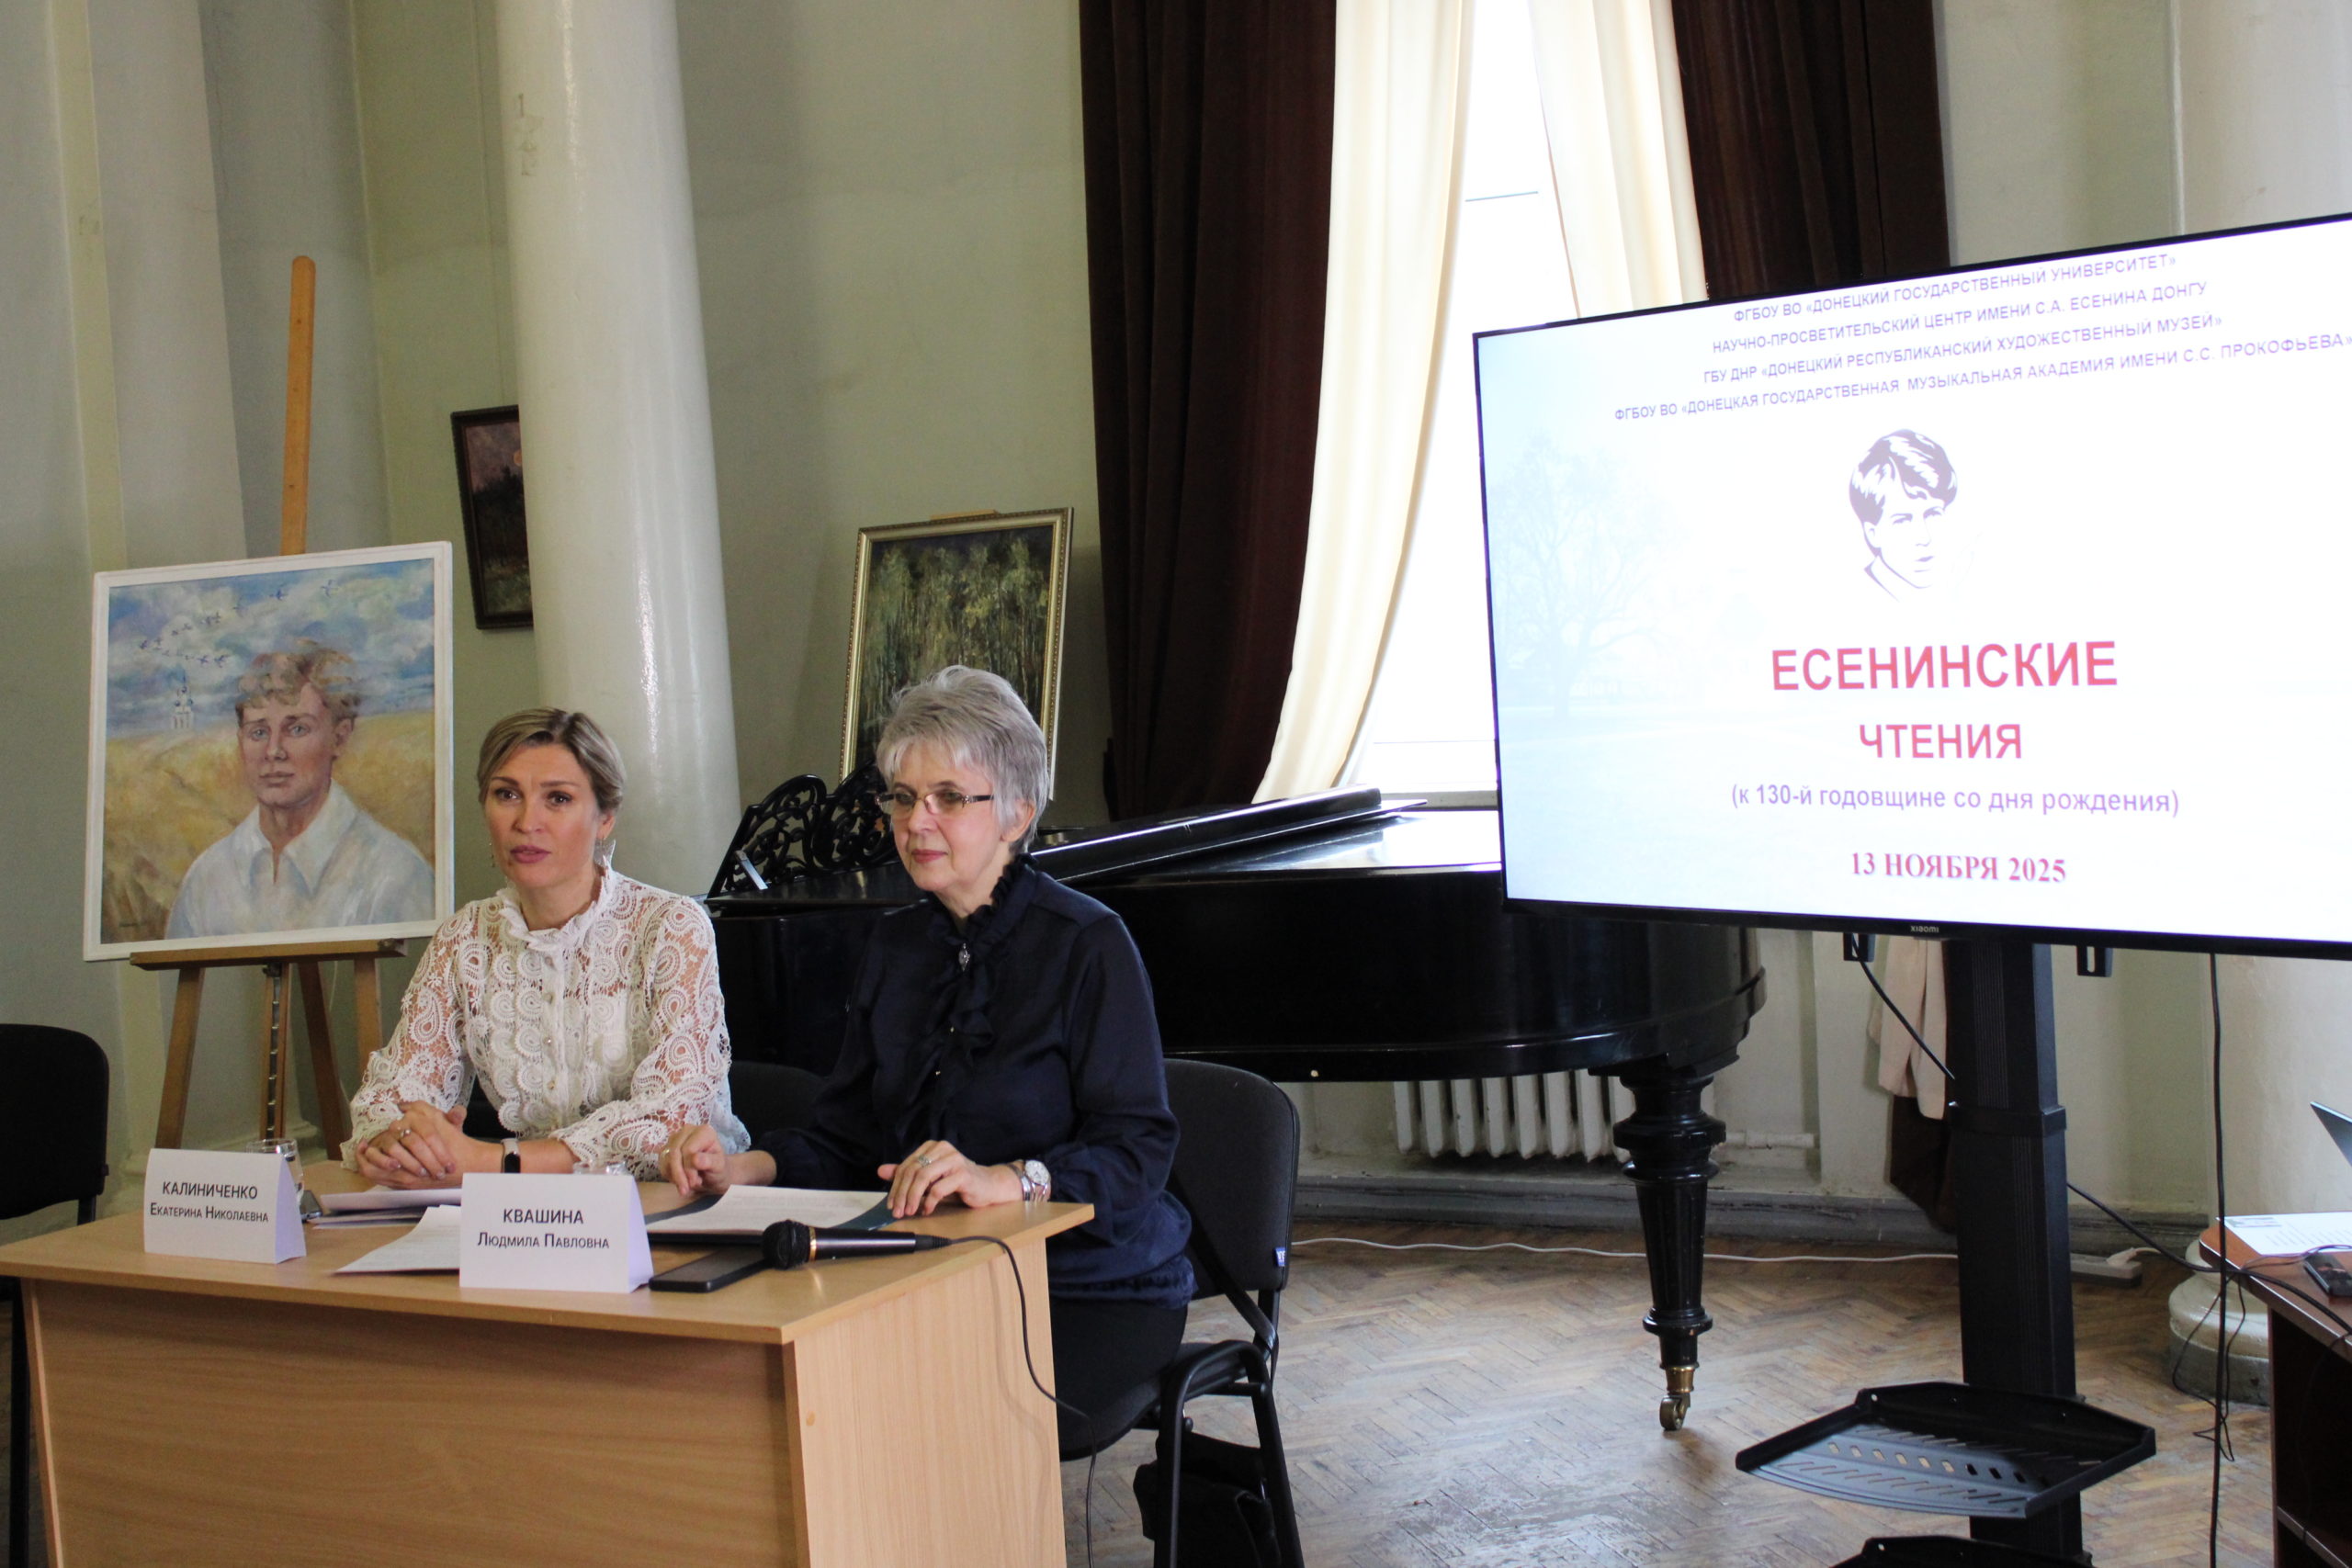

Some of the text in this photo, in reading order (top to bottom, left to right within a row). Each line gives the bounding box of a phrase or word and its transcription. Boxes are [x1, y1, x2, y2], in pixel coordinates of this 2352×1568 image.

[1735, 306, 1778, 321] ФГБОУ
[1783, 302, 1802, 316] ВО
[1894, 271, 2046, 300] ГОСУДАРСТВЕННЫЙ
[1713, 282, 2206, 353] НАУЧНО-ПРОСВЕТИТЕЛЬСКИЙ ЦЕНТР ИМЕНИ С.А. ЕСЕНИНА ДОНГУ
[1704, 370, 1726, 382] ГБУ
[1730, 367, 1757, 382] ДНР
[1848, 337, 1992, 367] РЕСПУБЛИКАНСКИЙ
[1997, 321, 2151, 350] ХУДОЖЕСТВЕННЫЙ
[1615, 406, 1656, 420] ФГБОУ
[1660, 403, 1677, 416] ВО
[1762, 379, 1899, 404] ГОСУДАРСТВЕННАЯ
[1907, 367, 2022, 389] МУЗЫКАЛЬНАЯ
[2028, 357, 2114, 378] АКАДЕМИЯ
[2120, 351, 2177, 368] ИМЕНИ
[2183, 347, 2216, 362] С.С.
[1771, 640, 2118, 691] ЕСЕНИНСКИЕ
[1859, 724, 2021, 759] ЧТЕНИЯ
[1732, 784, 2178, 818] (к 130-й годовщине со дня рождения)
[1852, 852, 2066, 883] 13 НОЯБРЯ 2025
[163, 1181, 258, 1200] КАЛИНИЧЕНКО
[503, 1208, 584, 1224] КВАШИНА
